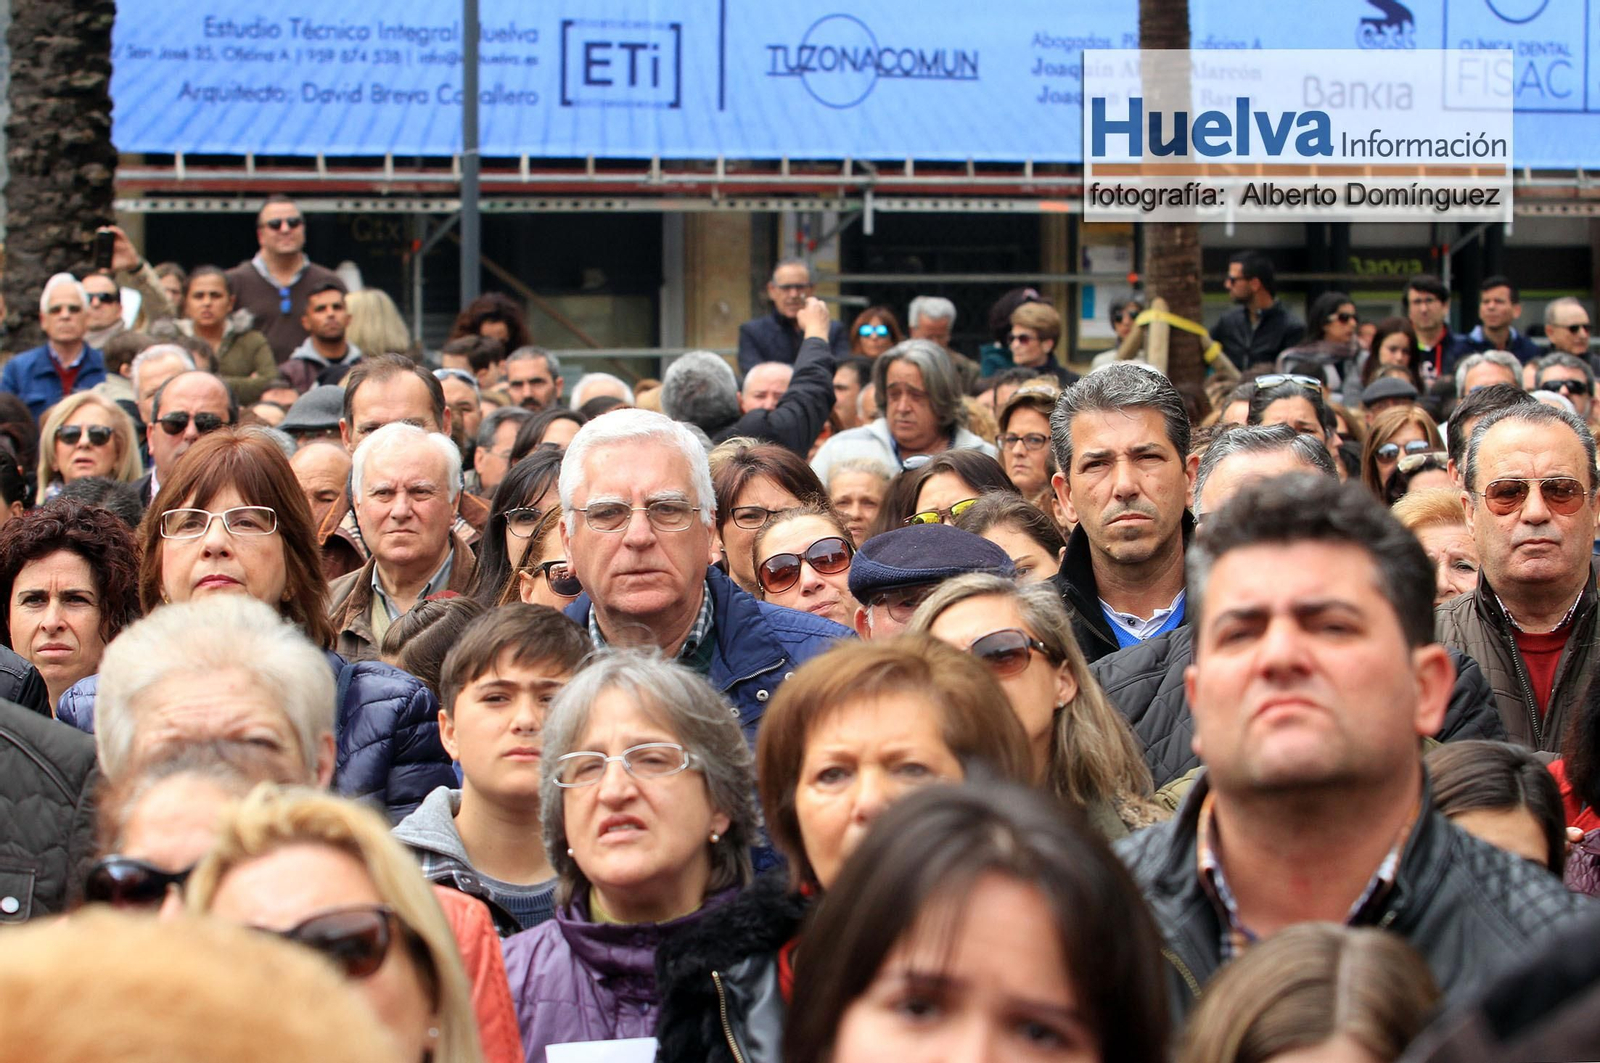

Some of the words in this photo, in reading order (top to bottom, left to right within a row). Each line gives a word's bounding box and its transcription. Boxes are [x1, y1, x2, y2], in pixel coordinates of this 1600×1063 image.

[204, 15, 282, 40] Estudio
[288, 16, 371, 42] Técnico
[378, 20, 460, 47] Integral
[479, 21, 539, 44] uelva
[584, 41, 659, 88] ETi
[766, 45, 979, 77] TUZONACOMUN
[302, 82, 362, 104] David
[437, 83, 540, 106] Caallero
